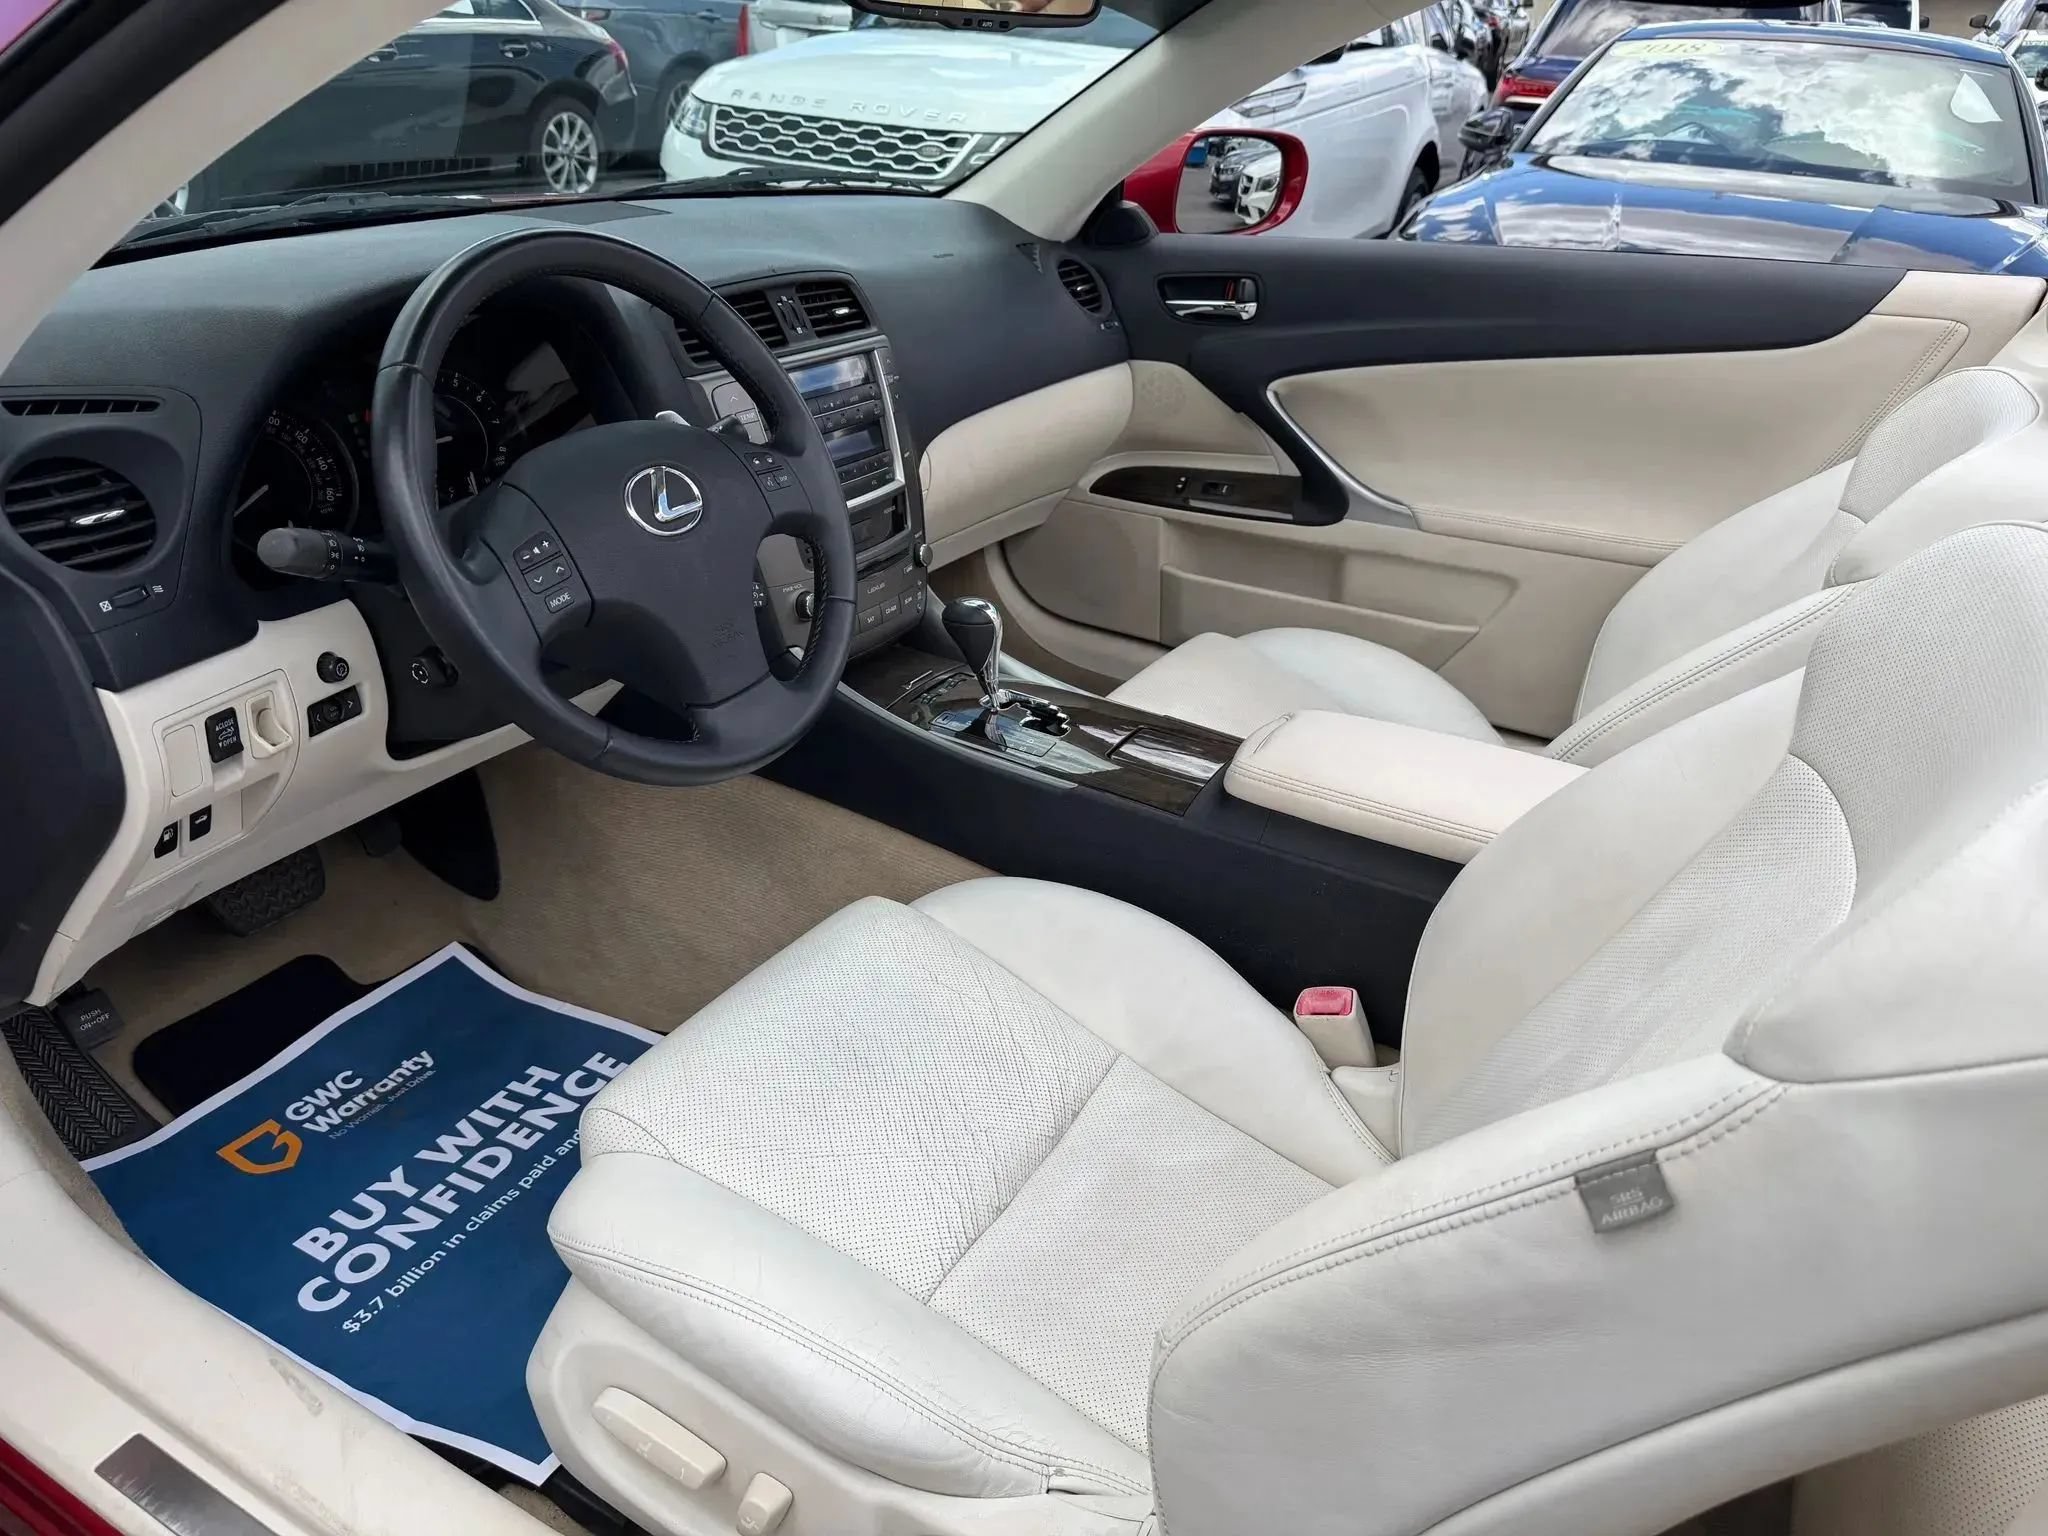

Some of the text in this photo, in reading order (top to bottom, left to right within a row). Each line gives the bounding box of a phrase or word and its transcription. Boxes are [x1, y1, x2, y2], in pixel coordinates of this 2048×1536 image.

[731, 88, 969, 124] RANGE ROVER
[295, 430, 309, 444] 120
[549, 592, 571, 608] MODE
[218, 717, 235, 730] CLOSE
[222, 735, 238, 748] OPEN
[80, 1008, 102, 1021] PUSH
[286, 1070, 363, 1123] GWC
[302, 1050, 435, 1134] Warranty
[292, 1065, 562, 1264] BUY WITH
[297, 1051, 629, 1312] CONFIDENCE
[1609, 1186, 1644, 1203] SRS
[1601, 1196, 1664, 1225] AIRBAG
[342, 1296, 385, 1334] $3.7
[387, 1250, 447, 1299] billion
[444, 1232, 467, 1260] in
[465, 1187, 521, 1233] claims
[518, 1154, 557, 1190] paid
